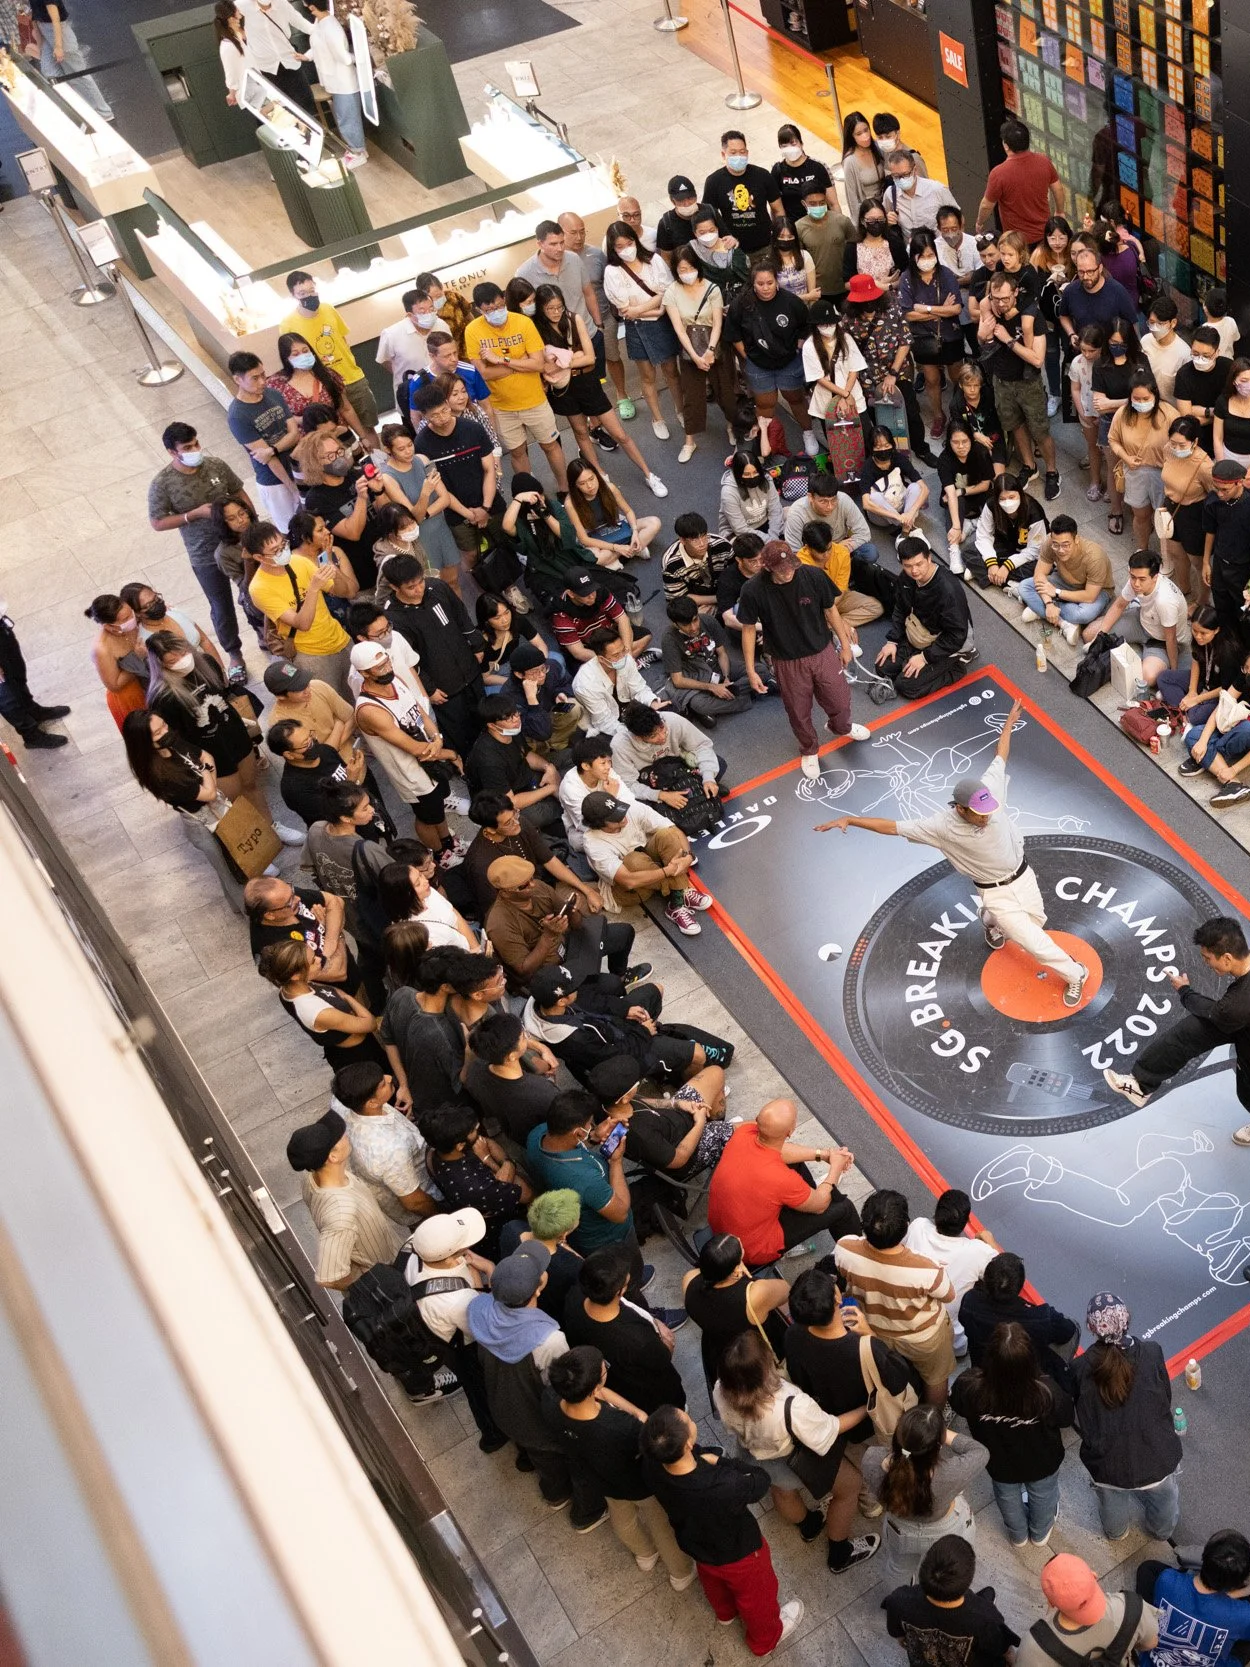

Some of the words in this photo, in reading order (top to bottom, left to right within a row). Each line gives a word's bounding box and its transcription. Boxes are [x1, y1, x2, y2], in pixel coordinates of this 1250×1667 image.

[944, 47, 963, 72] SALE
[783, 177, 800, 185] FILA
[458, 268, 487, 285] ONLY
[480, 333, 524, 349] HILFIGER
[237, 828, 262, 854] Typo
[1055, 876, 1179, 983] CHAMPS
[1081, 993, 1172, 1071] 2022
[1142, 1286, 1217, 1340] sgbreakingchamps.com
